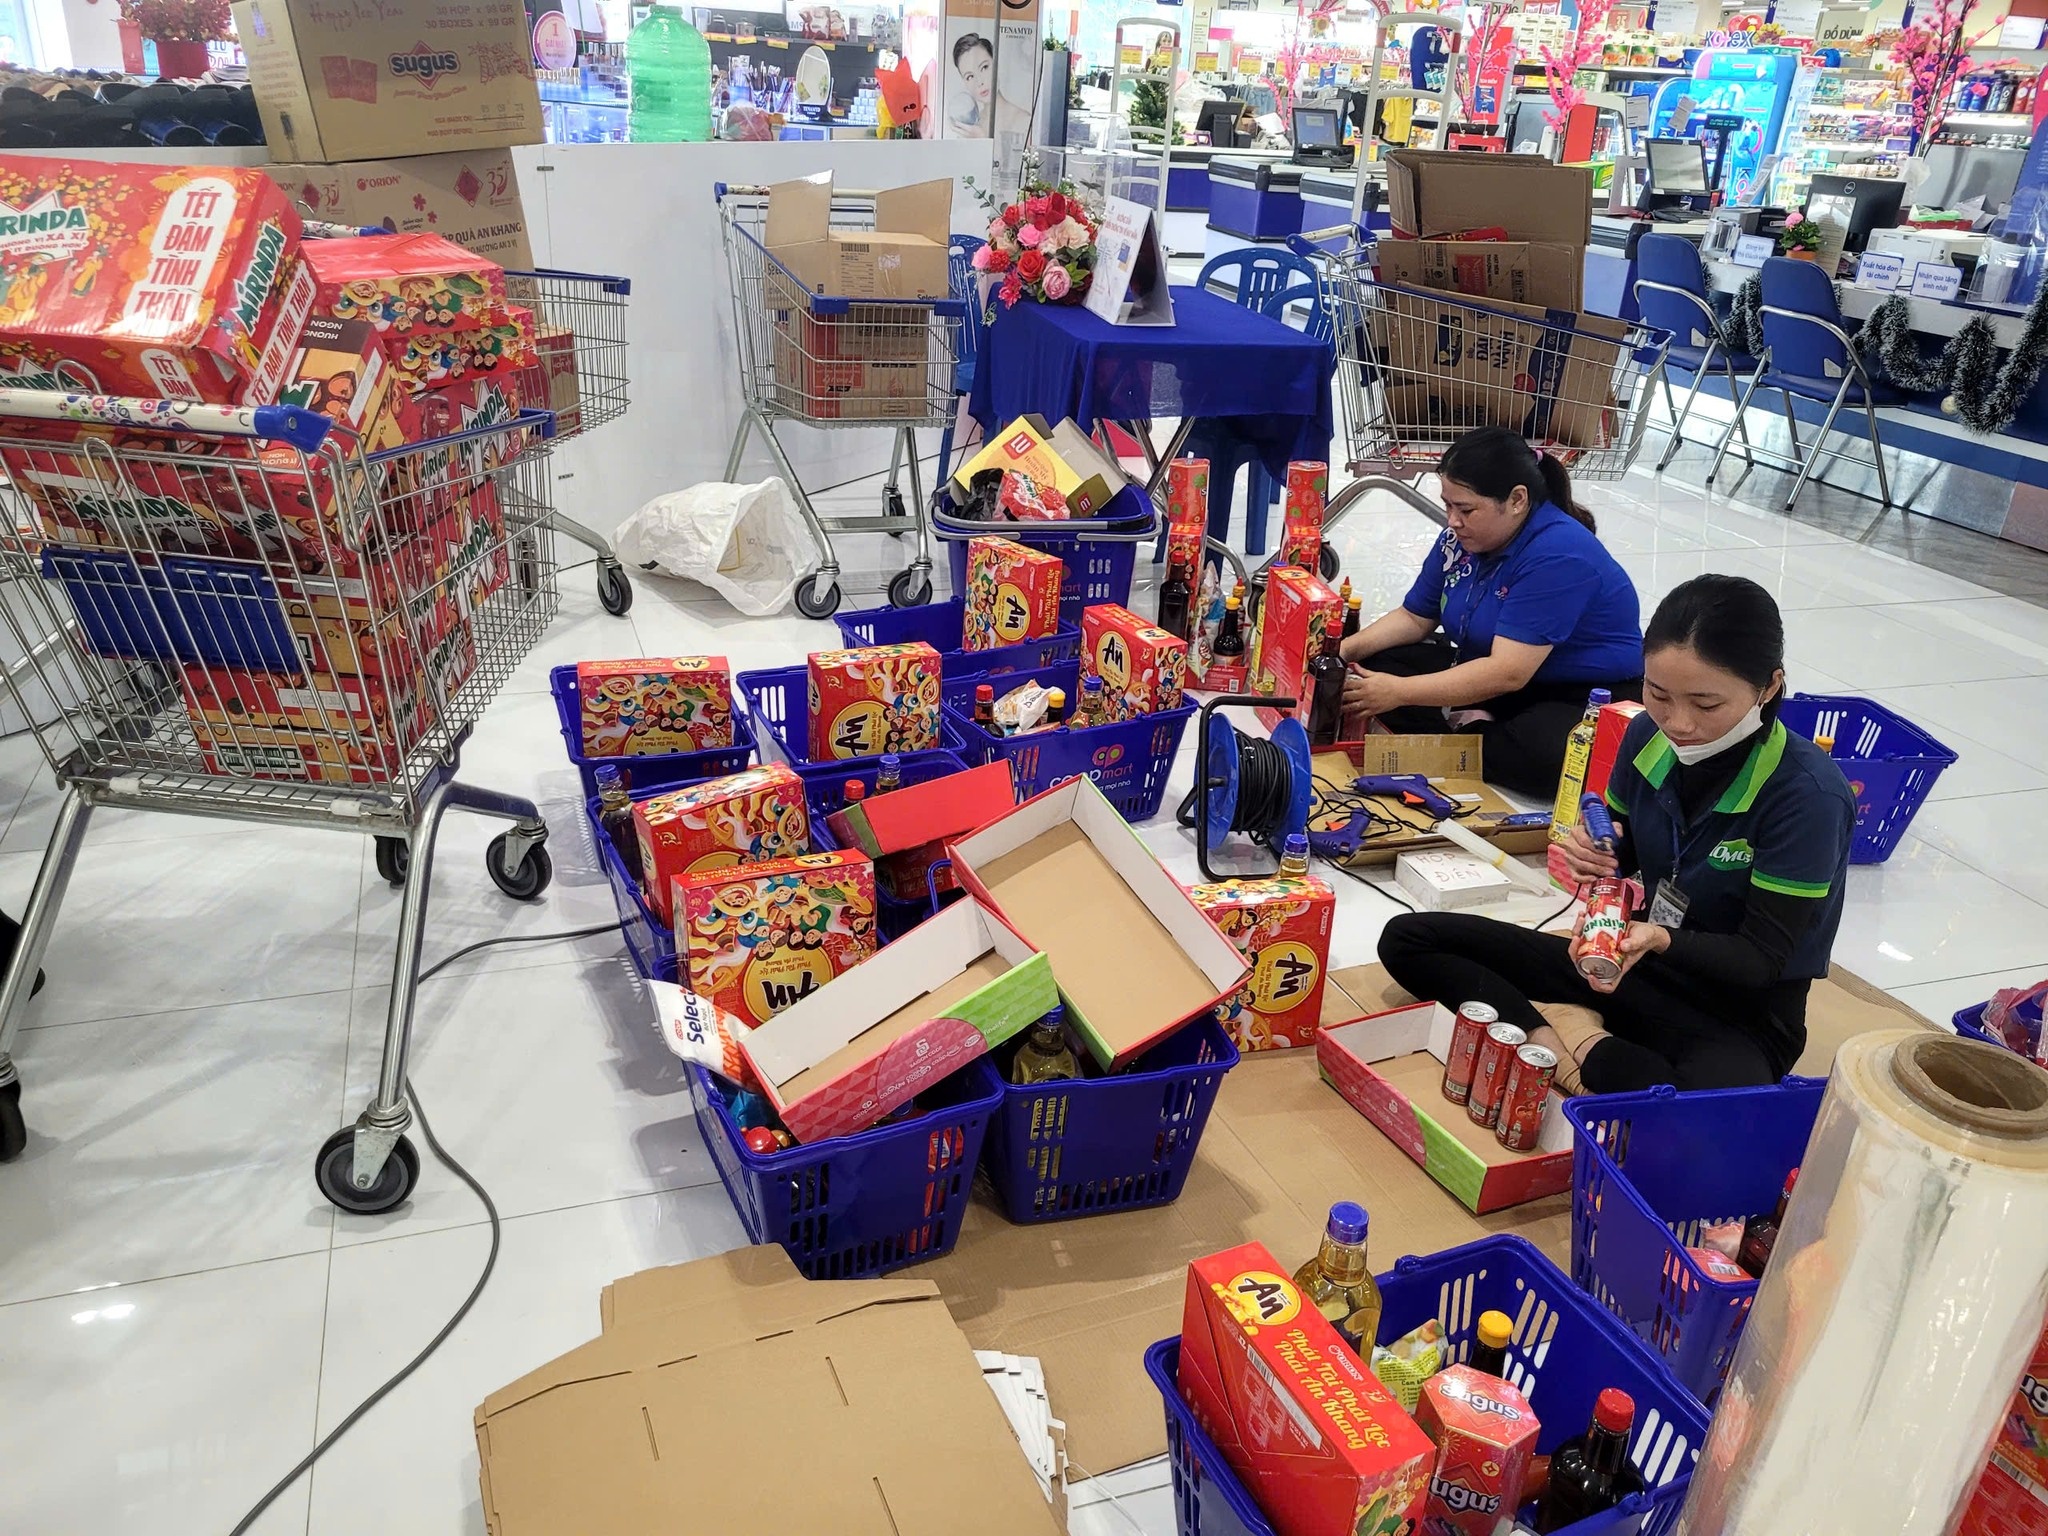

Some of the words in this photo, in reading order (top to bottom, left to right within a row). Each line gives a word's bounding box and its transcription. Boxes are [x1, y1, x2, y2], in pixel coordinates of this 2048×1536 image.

[440, 19, 473, 28] BOXES
[502, 18, 515, 26] GR
[1000, 26, 1032, 35] TENAMYD
[391, 53, 458, 77] sugus
[369, 176, 399, 188] ORION
[183, 186, 223, 218] TẾT
[162, 220, 215, 253] ĐẬM
[456, 227, 477, 244] QUÀ
[477, 227, 490, 239] AN
[491, 222, 522, 237] KHANG
[151, 252, 202, 286] TÌNH
[1863, 261, 1875, 270] Xuất
[1876, 263, 1886, 271] hóa
[133, 288, 193, 322] THÂN
[252, 375, 270, 406] TẾT
[264, 341, 284, 383] ĐẬM
[277, 310, 297, 350] TÌNH
[291, 276, 314, 317] THÂN
[310, 320, 343, 330] NGON
[150, 356, 180, 376] TẾT
[1010, 434, 1031, 454] LU
[1005, 595, 1027, 629] An
[1102, 636, 1124, 674] An
[835, 713, 870, 757] An
[1118, 779, 1131, 788] nhà
[803, 855, 834, 865] An
[1273, 952, 1314, 1000] An
[1238, 1277, 1286, 1320] An
[1275, 1340, 1310, 1375] Phát
[1301, 1375, 1327, 1400] An
[1321, 1398, 1368, 1451] Khang
[1287, 1328, 1322, 1362] Phát
[1335, 1386, 1372, 1423] Phát
[1364, 1422, 1391, 1450] Lộc
[1431, 1477, 1501, 1513] ugus
